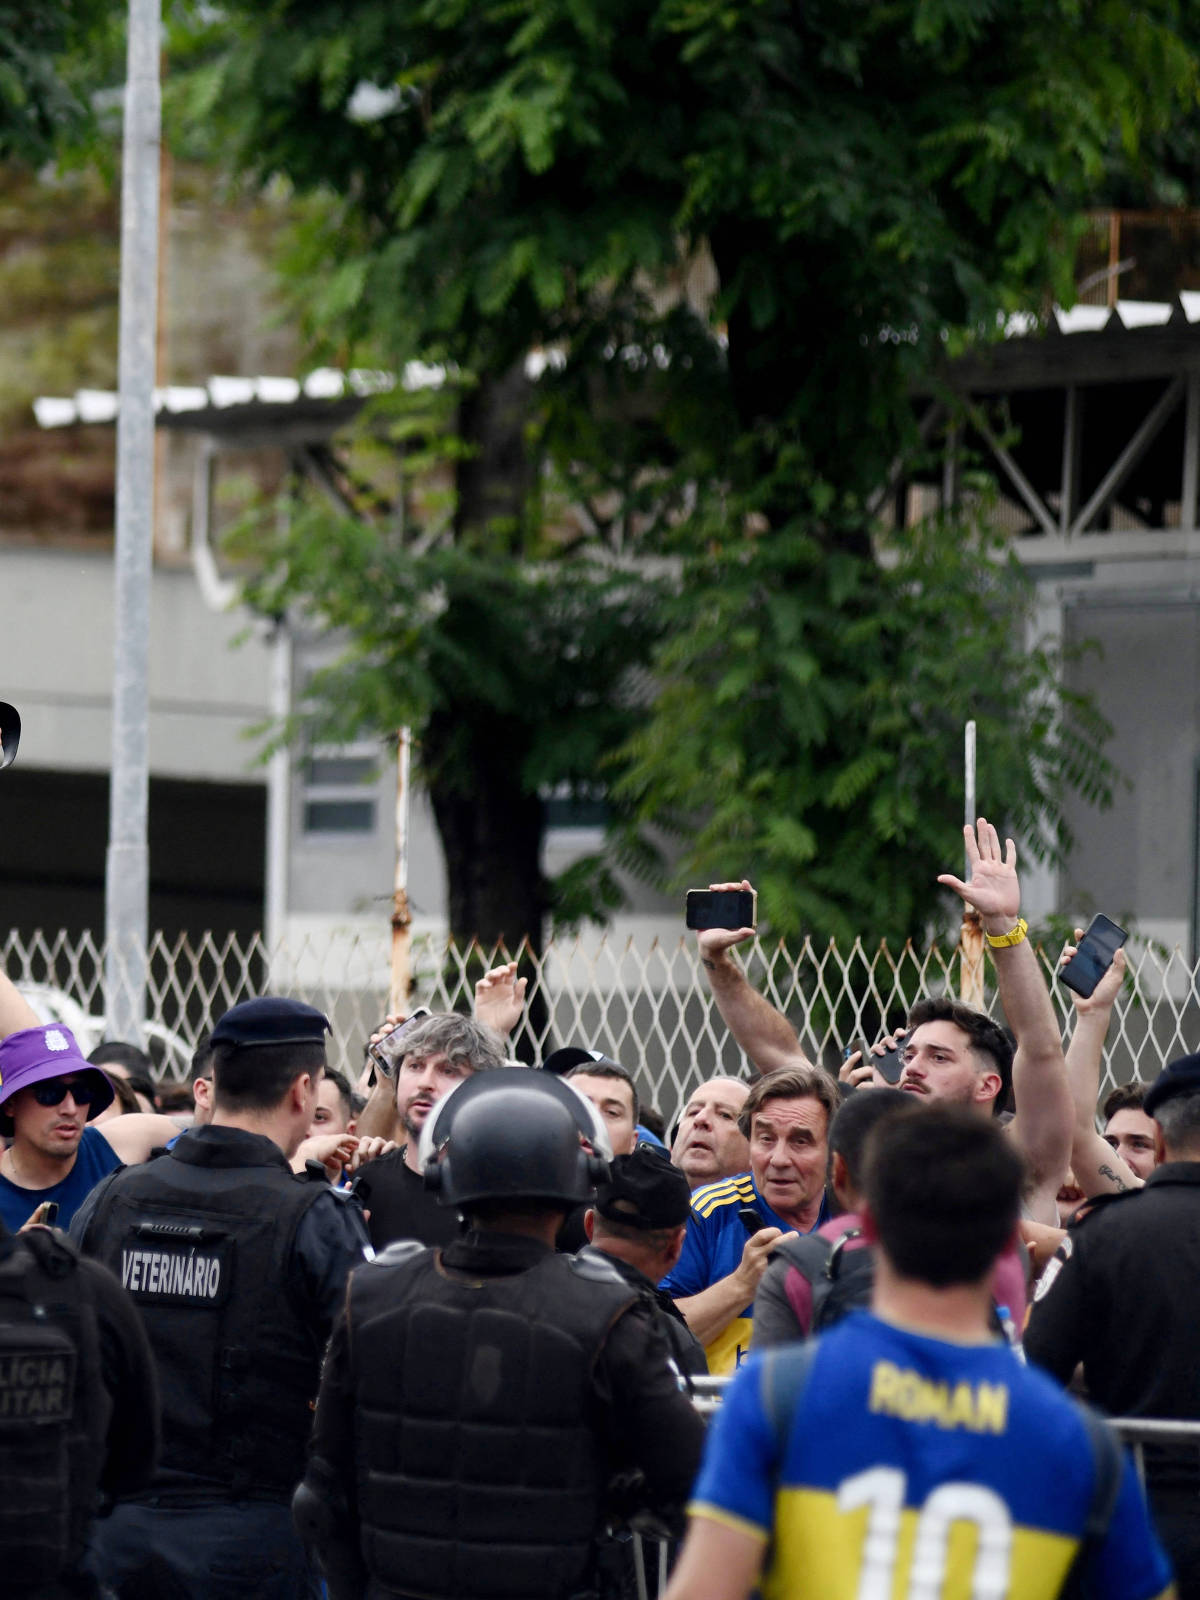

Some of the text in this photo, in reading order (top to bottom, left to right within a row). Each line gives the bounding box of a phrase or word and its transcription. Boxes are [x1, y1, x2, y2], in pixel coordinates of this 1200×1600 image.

[122, 1248, 220, 1298] VETERINÁRIO
[869, 1359, 1009, 1435] ROMAN
[837, 1465, 1013, 1600] 10
